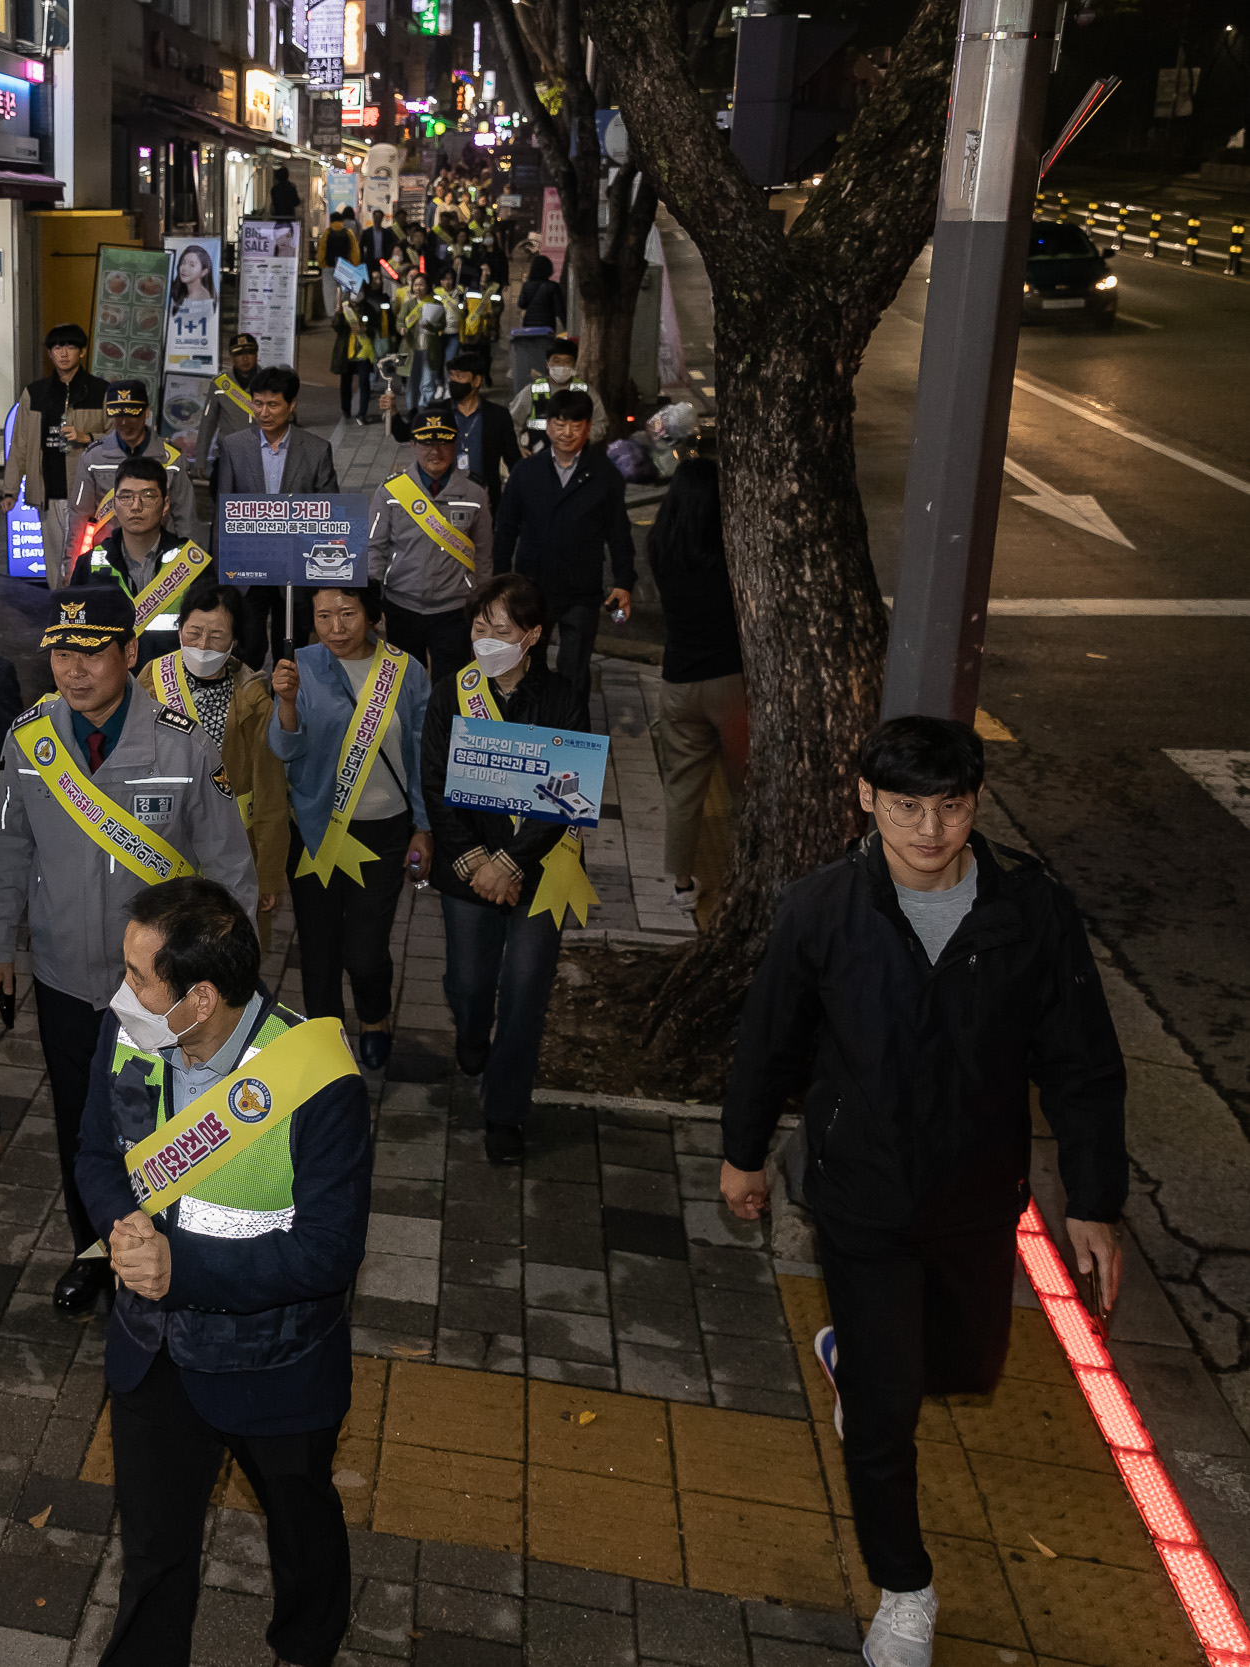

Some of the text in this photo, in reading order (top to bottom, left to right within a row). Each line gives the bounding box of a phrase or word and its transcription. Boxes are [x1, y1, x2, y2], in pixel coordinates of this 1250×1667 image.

[244, 240, 269, 252] SALE
[174, 317, 207, 336] 1+1
[225, 501, 330, 520] 건대맛의 거리!
[225, 521, 350, 534] 청춘에 안전과 품격을 더하다
[369, 658, 398, 709] 안전하고
[355, 705, 384, 748] 건전한
[338, 744, 368, 787] 청년의
[455, 750, 548, 774] 청춘에 안전과 품격
[57, 771, 105, 824] 범죄없는
[461, 793, 532, 812] 긴급신고는 112
[138, 813, 170, 821] POLICE
